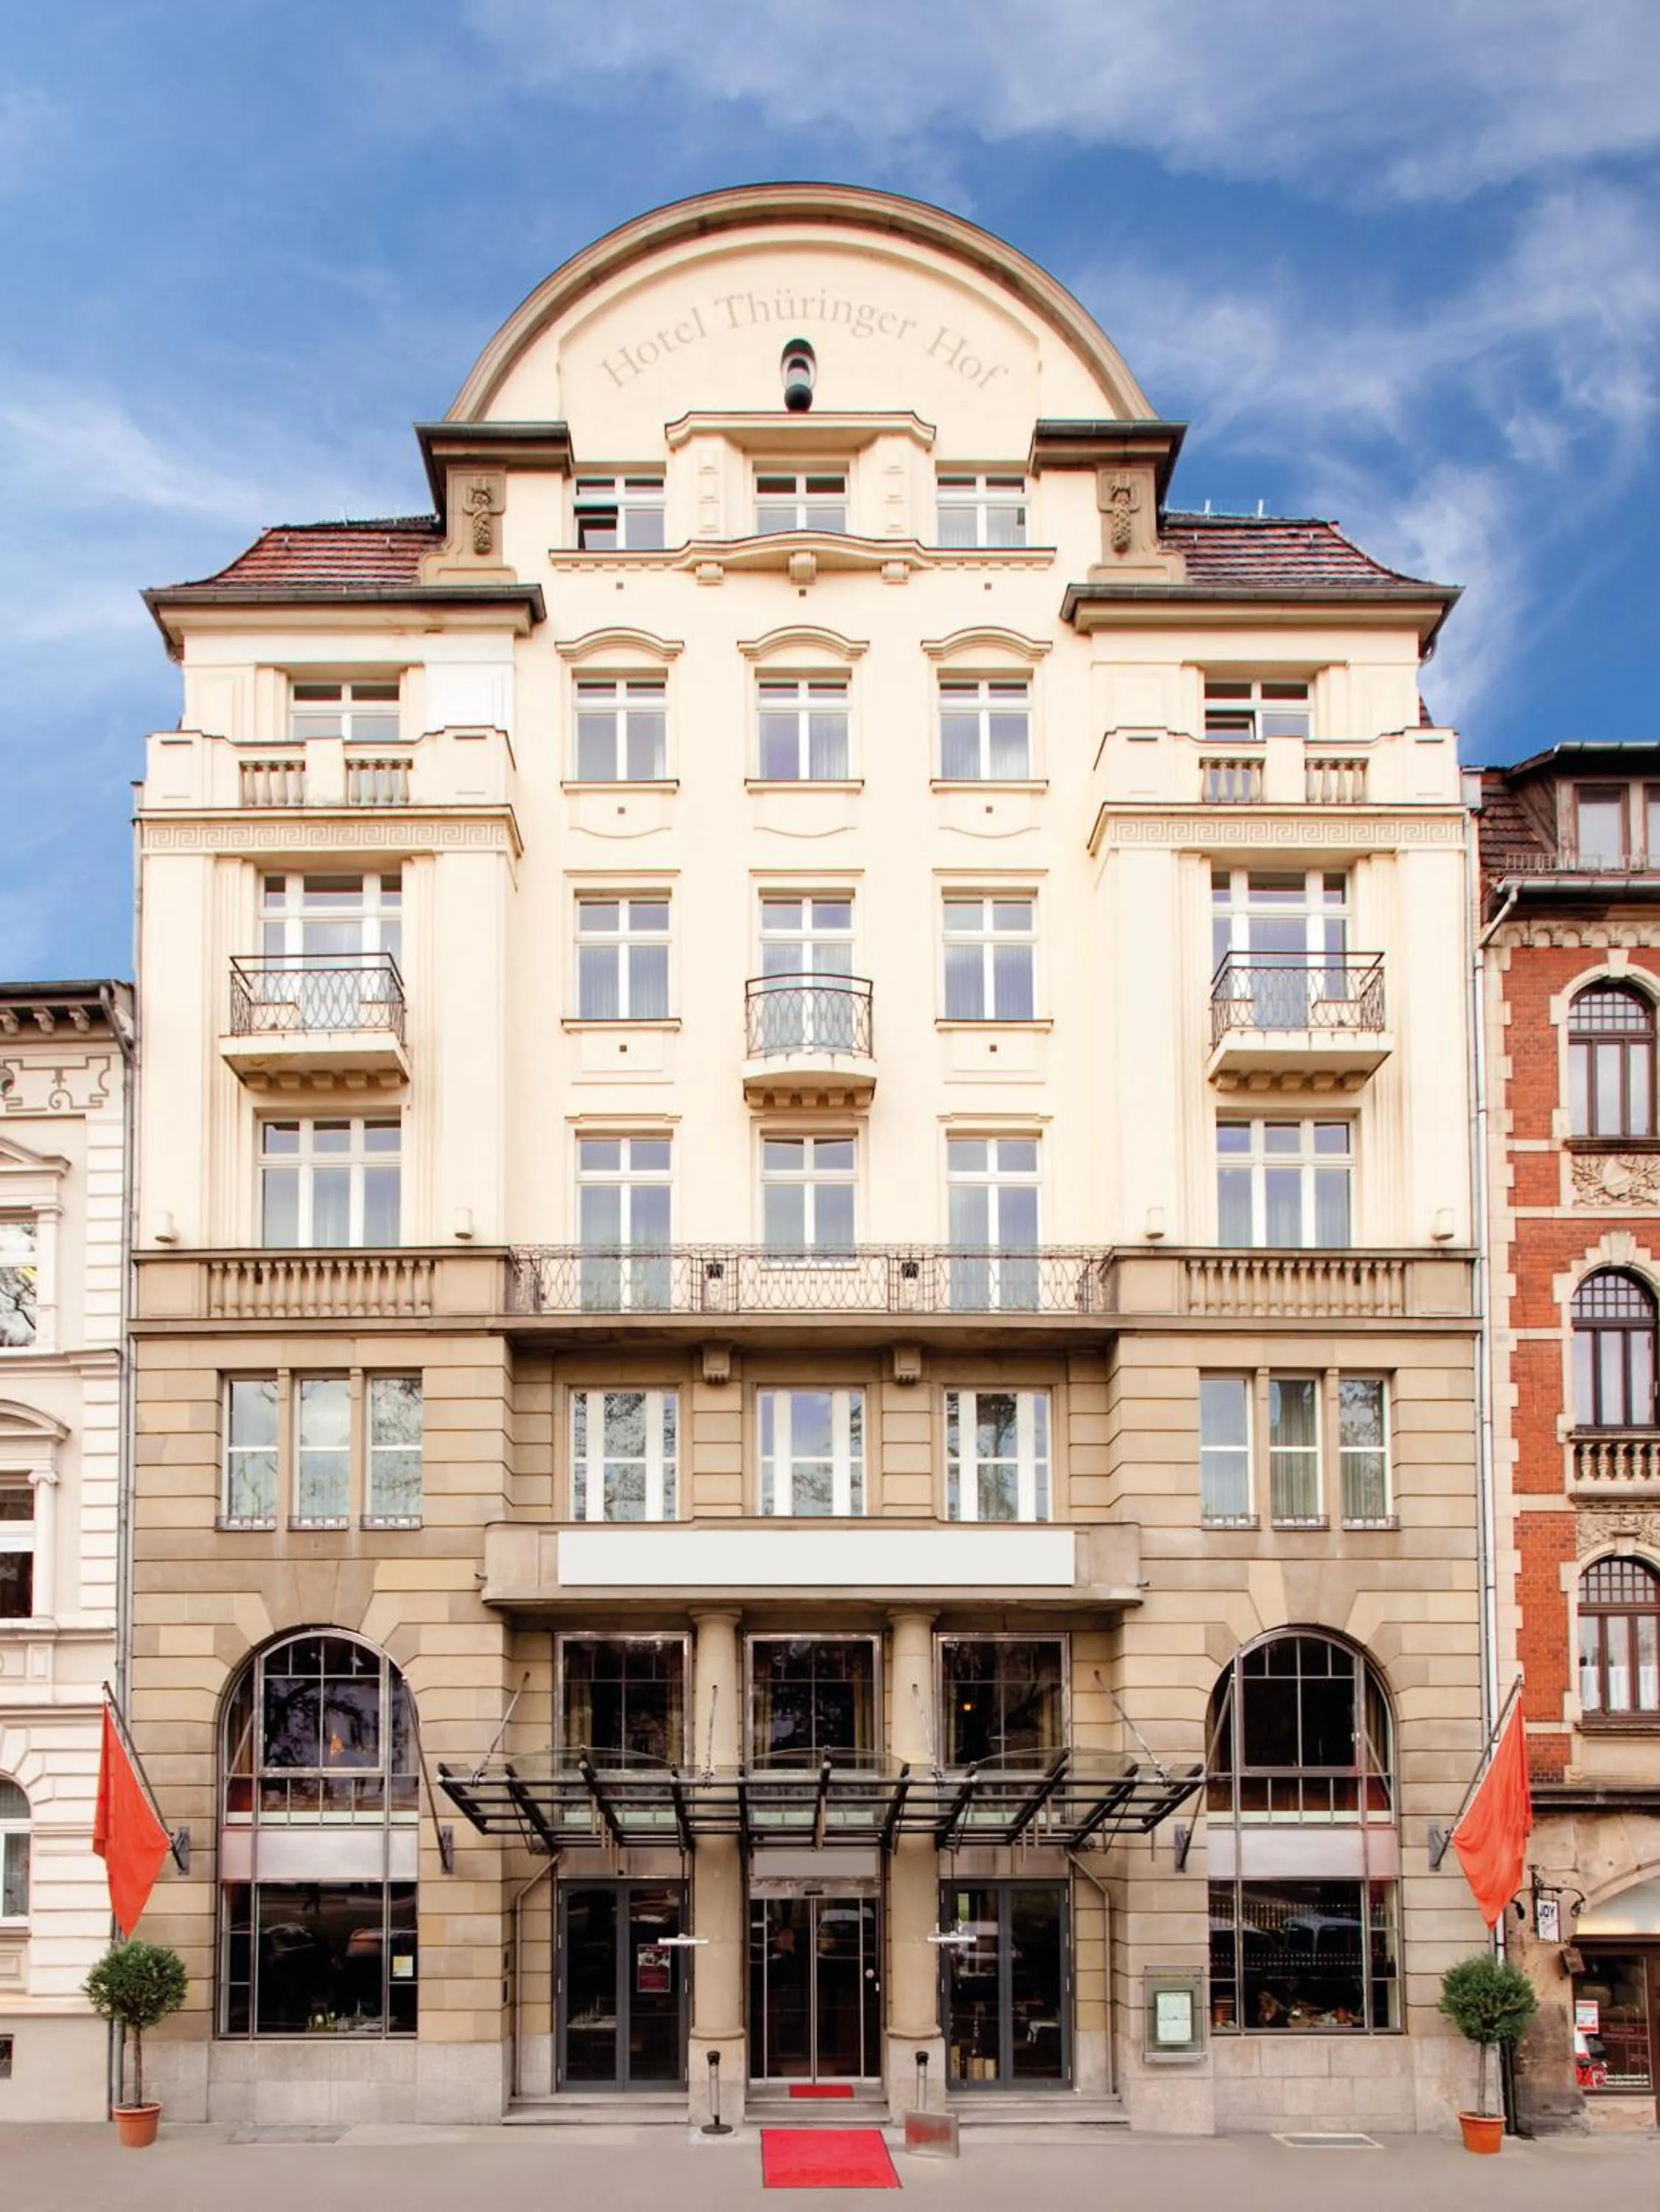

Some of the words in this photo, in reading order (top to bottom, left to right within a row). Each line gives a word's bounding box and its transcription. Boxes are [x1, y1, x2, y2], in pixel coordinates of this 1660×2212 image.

[600, 307, 708, 389] Hotel
[714, 287, 917, 341] Thüringer
[926, 325, 1010, 391] Hof
[1538, 1904, 1556, 1919] JOY
